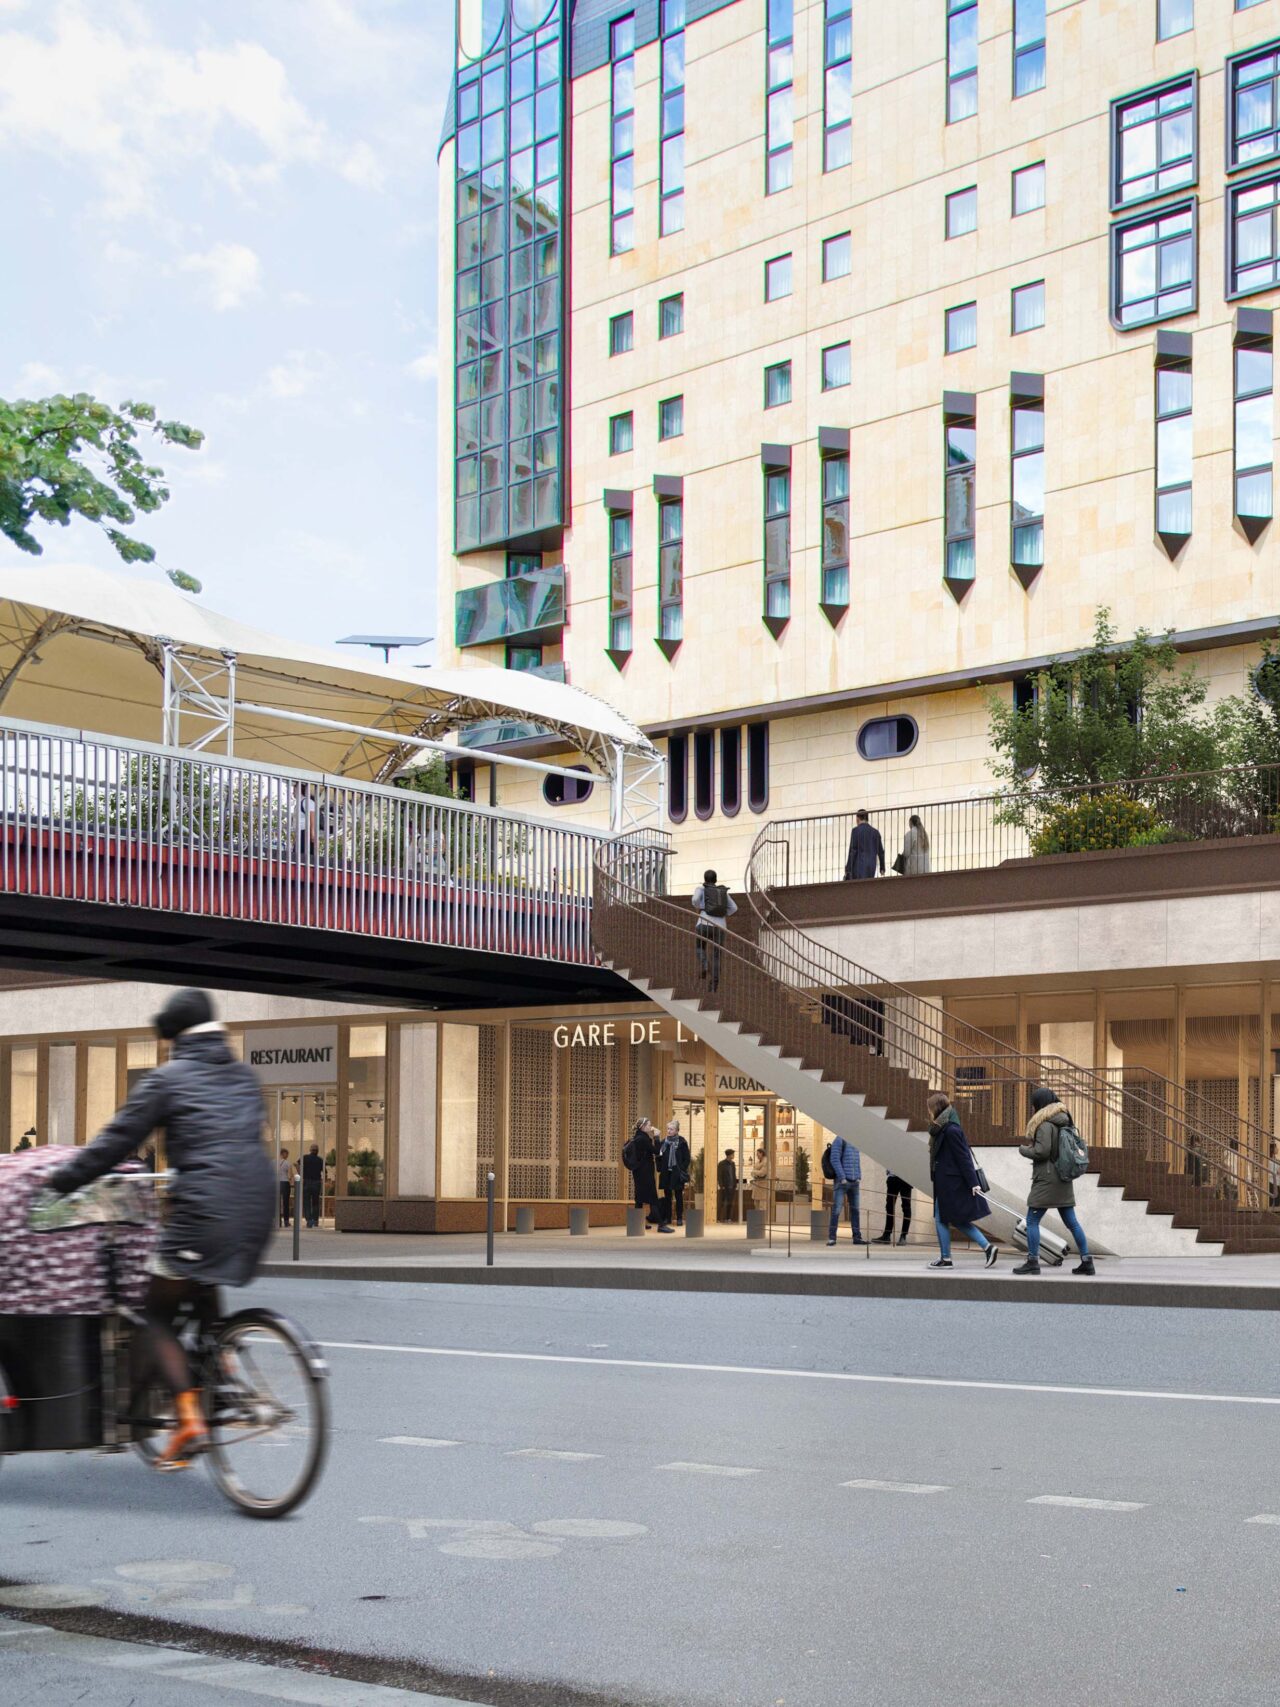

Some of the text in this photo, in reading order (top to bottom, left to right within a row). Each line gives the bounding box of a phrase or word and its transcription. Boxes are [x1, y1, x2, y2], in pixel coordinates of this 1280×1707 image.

[553, 1022, 615, 1048] GARE
[630, 1019, 661, 1045] DE
[250, 1046, 333, 1066] RESTAURANT
[684, 1071, 771, 1092] RESAURAN
